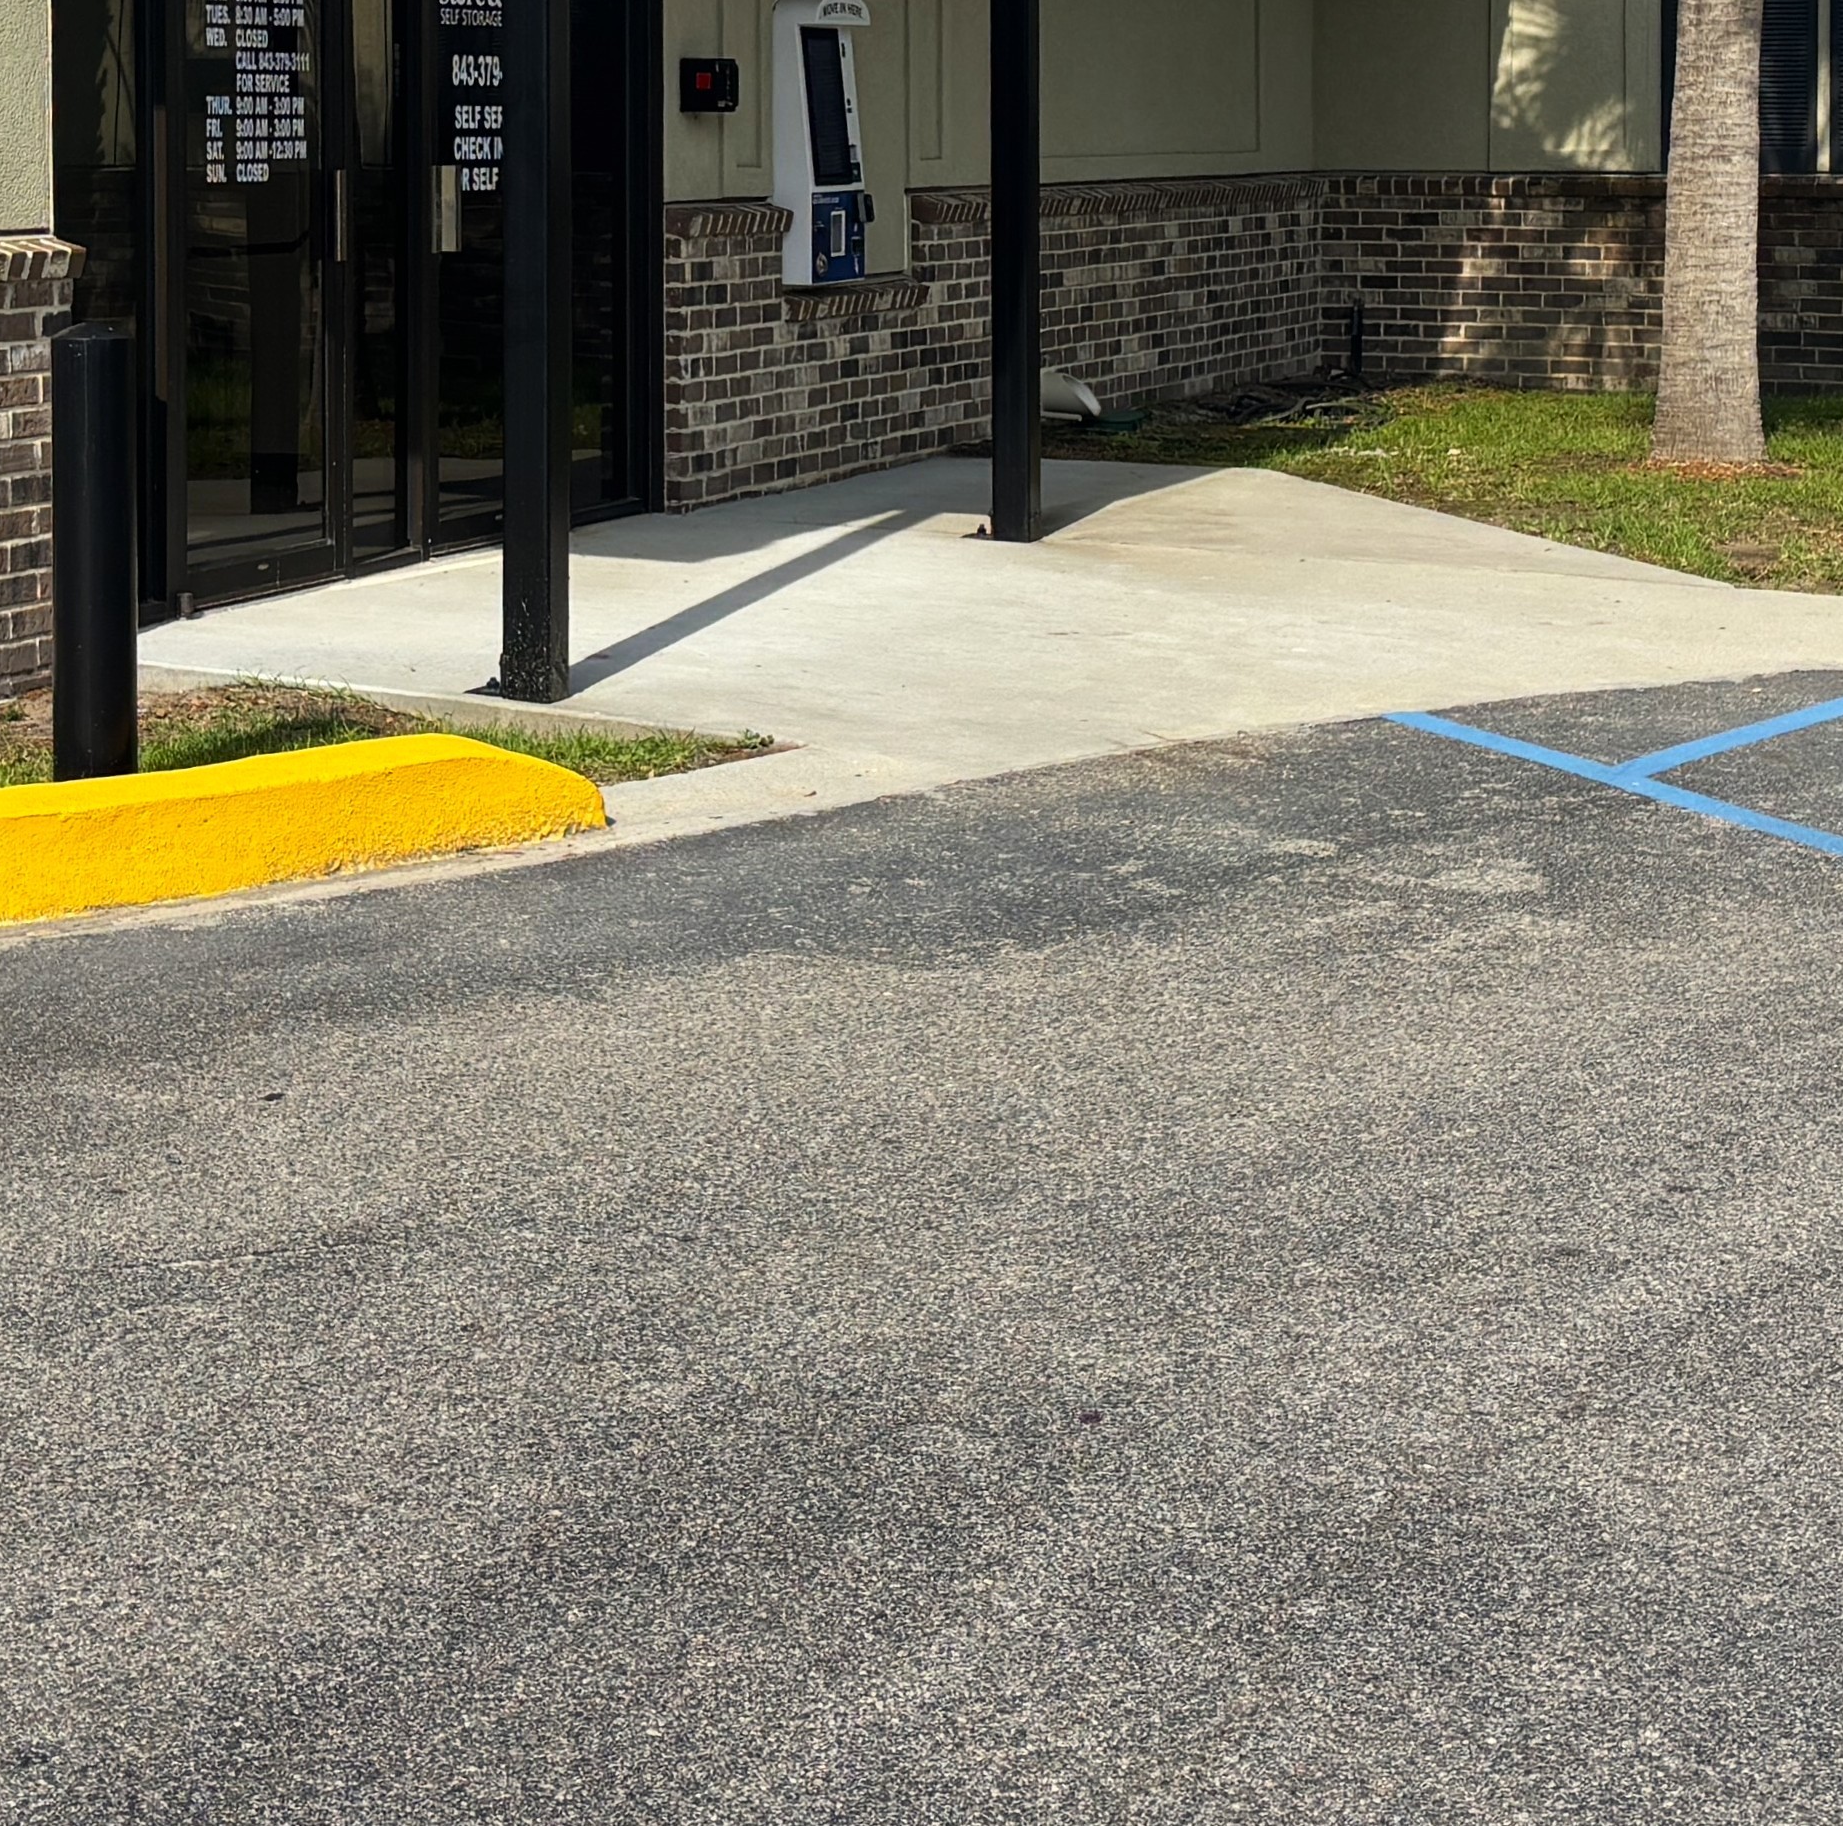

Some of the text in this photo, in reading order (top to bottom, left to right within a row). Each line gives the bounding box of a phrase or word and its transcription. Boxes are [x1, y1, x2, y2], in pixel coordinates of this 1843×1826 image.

[205, 5, 231, 24] TUES.
[255, 7, 267, 26] AM
[292, 9, 305, 27] PM
[440, 8, 502, 26] SELF STORAGE
[206, 27, 268, 48] WED. CLOSED
[236, 51, 310, 72] CALL 843-379-3111
[237, 73, 290, 93] FOR SERVICE
[206, 96, 233, 115] THUR.
[236, 96, 254, 115] 9:00
[255, 96, 268, 115] AM
[273, 96, 291, 115] 3:00
[292, 96, 305, 115] PM
[455, 105, 482, 129] SELF
[206, 118, 223, 138] FRI.
[236, 118, 254, 137] 9:00
[255, 118, 268, 137] AM
[273, 118, 291, 137] 3:00
[292, 118, 305, 137] PM
[206, 141, 225, 160] SAT.
[236, 141, 254, 160] 9:00
[255, 141, 268, 160] AM
[294, 140, 307, 159] PM
[454, 136, 492, 160] CHECK
[206, 163, 269, 183] SUN. CLOSED
[472, 167, 499, 191] SELF
